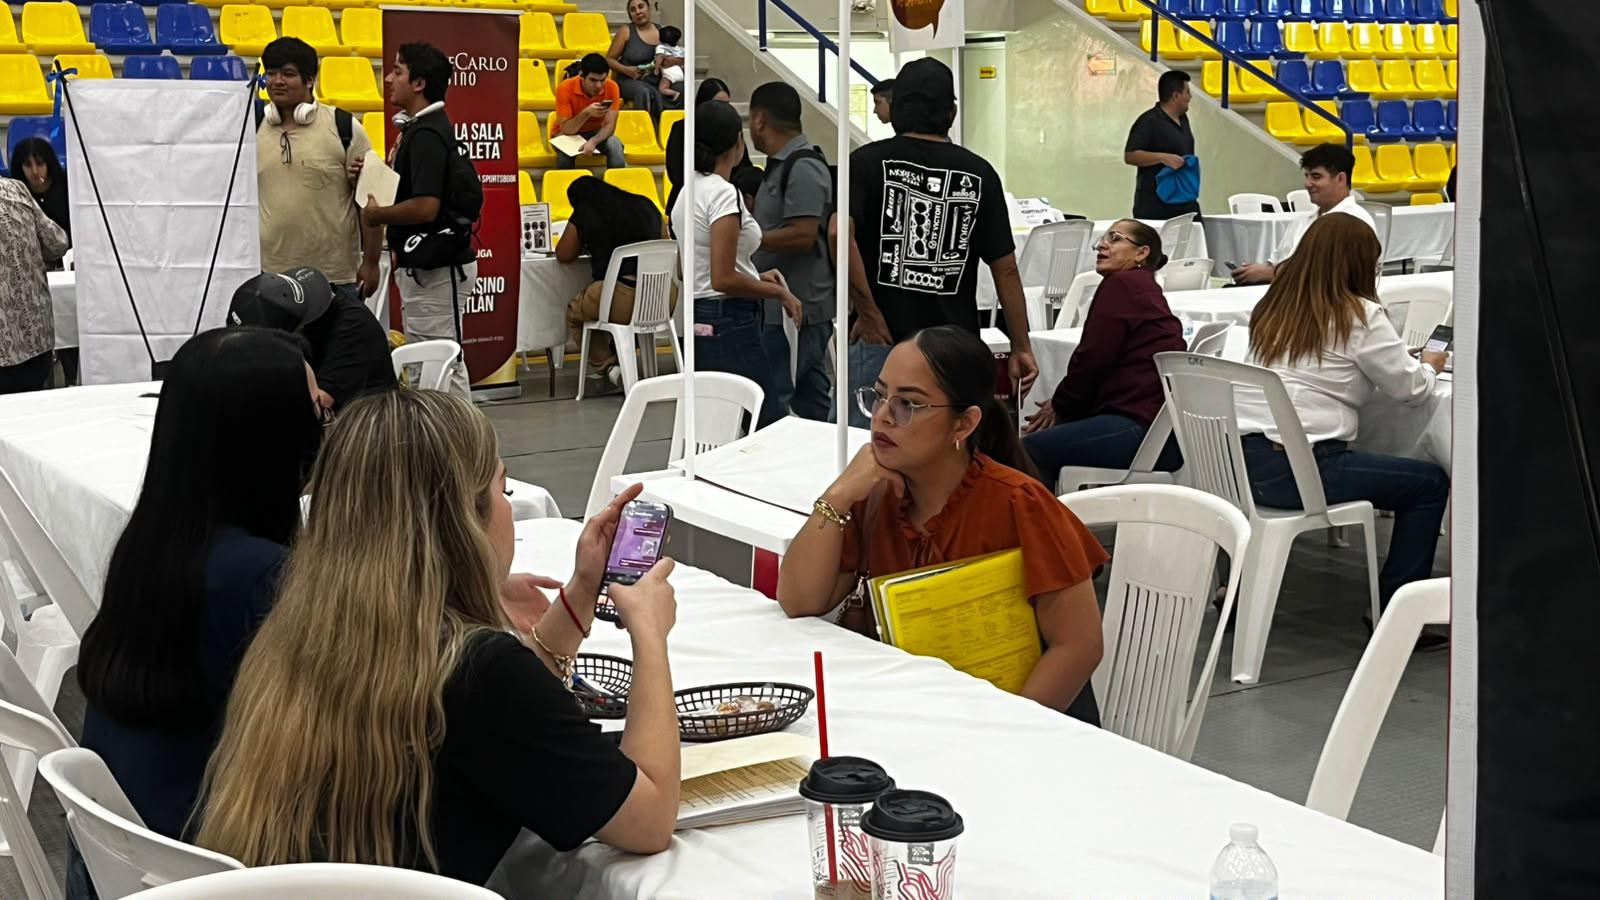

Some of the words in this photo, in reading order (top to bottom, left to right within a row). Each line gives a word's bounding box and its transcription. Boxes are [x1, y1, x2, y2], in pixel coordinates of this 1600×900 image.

[454, 123, 469, 140] LA
[471, 122, 504, 141] SALA
[932, 205, 942, 230] VICTOR
[958, 210, 973, 250] MORESA
